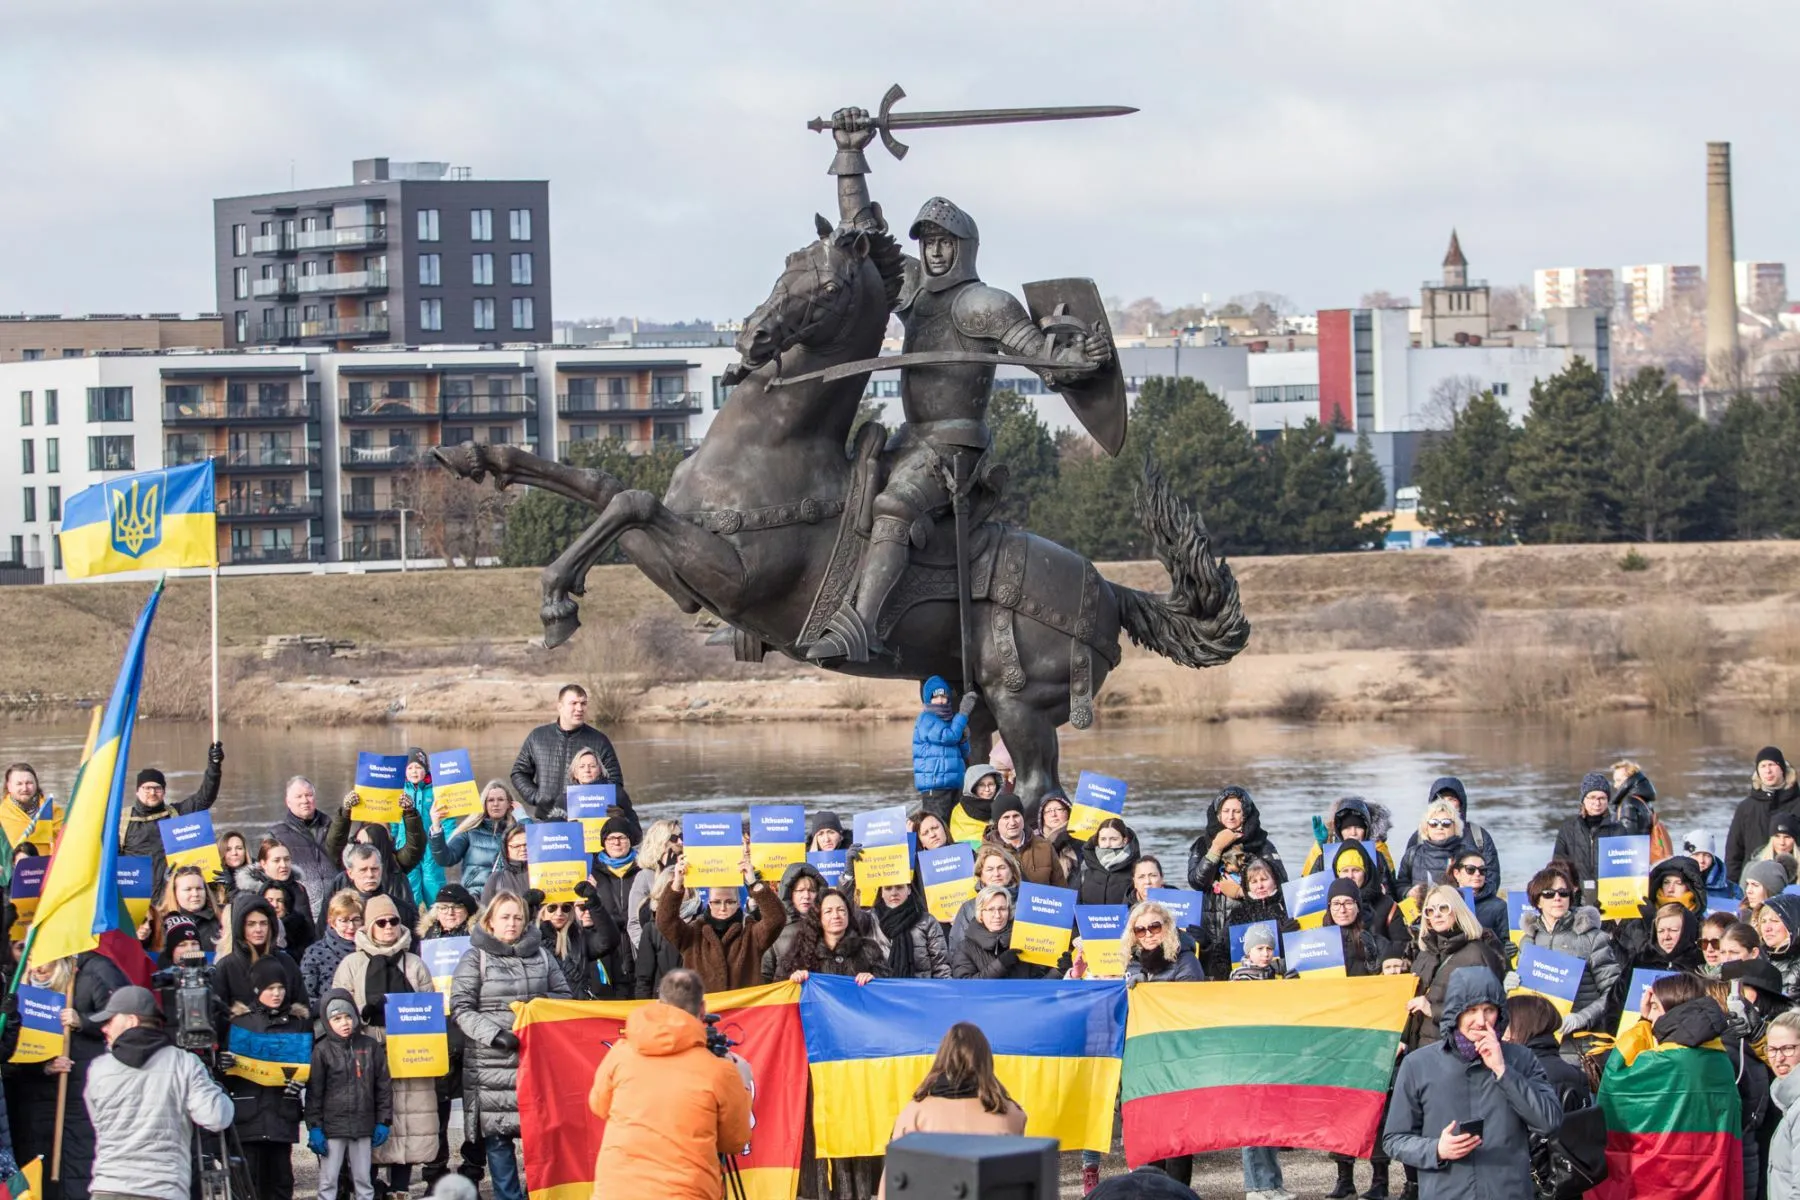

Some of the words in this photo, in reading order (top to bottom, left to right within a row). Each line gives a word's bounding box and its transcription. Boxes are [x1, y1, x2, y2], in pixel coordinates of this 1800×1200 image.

[932, 855, 961, 868] Ukrainian
[1031, 896, 1062, 908] Ukrainian
[1532, 969, 1560, 983] Ukraine
